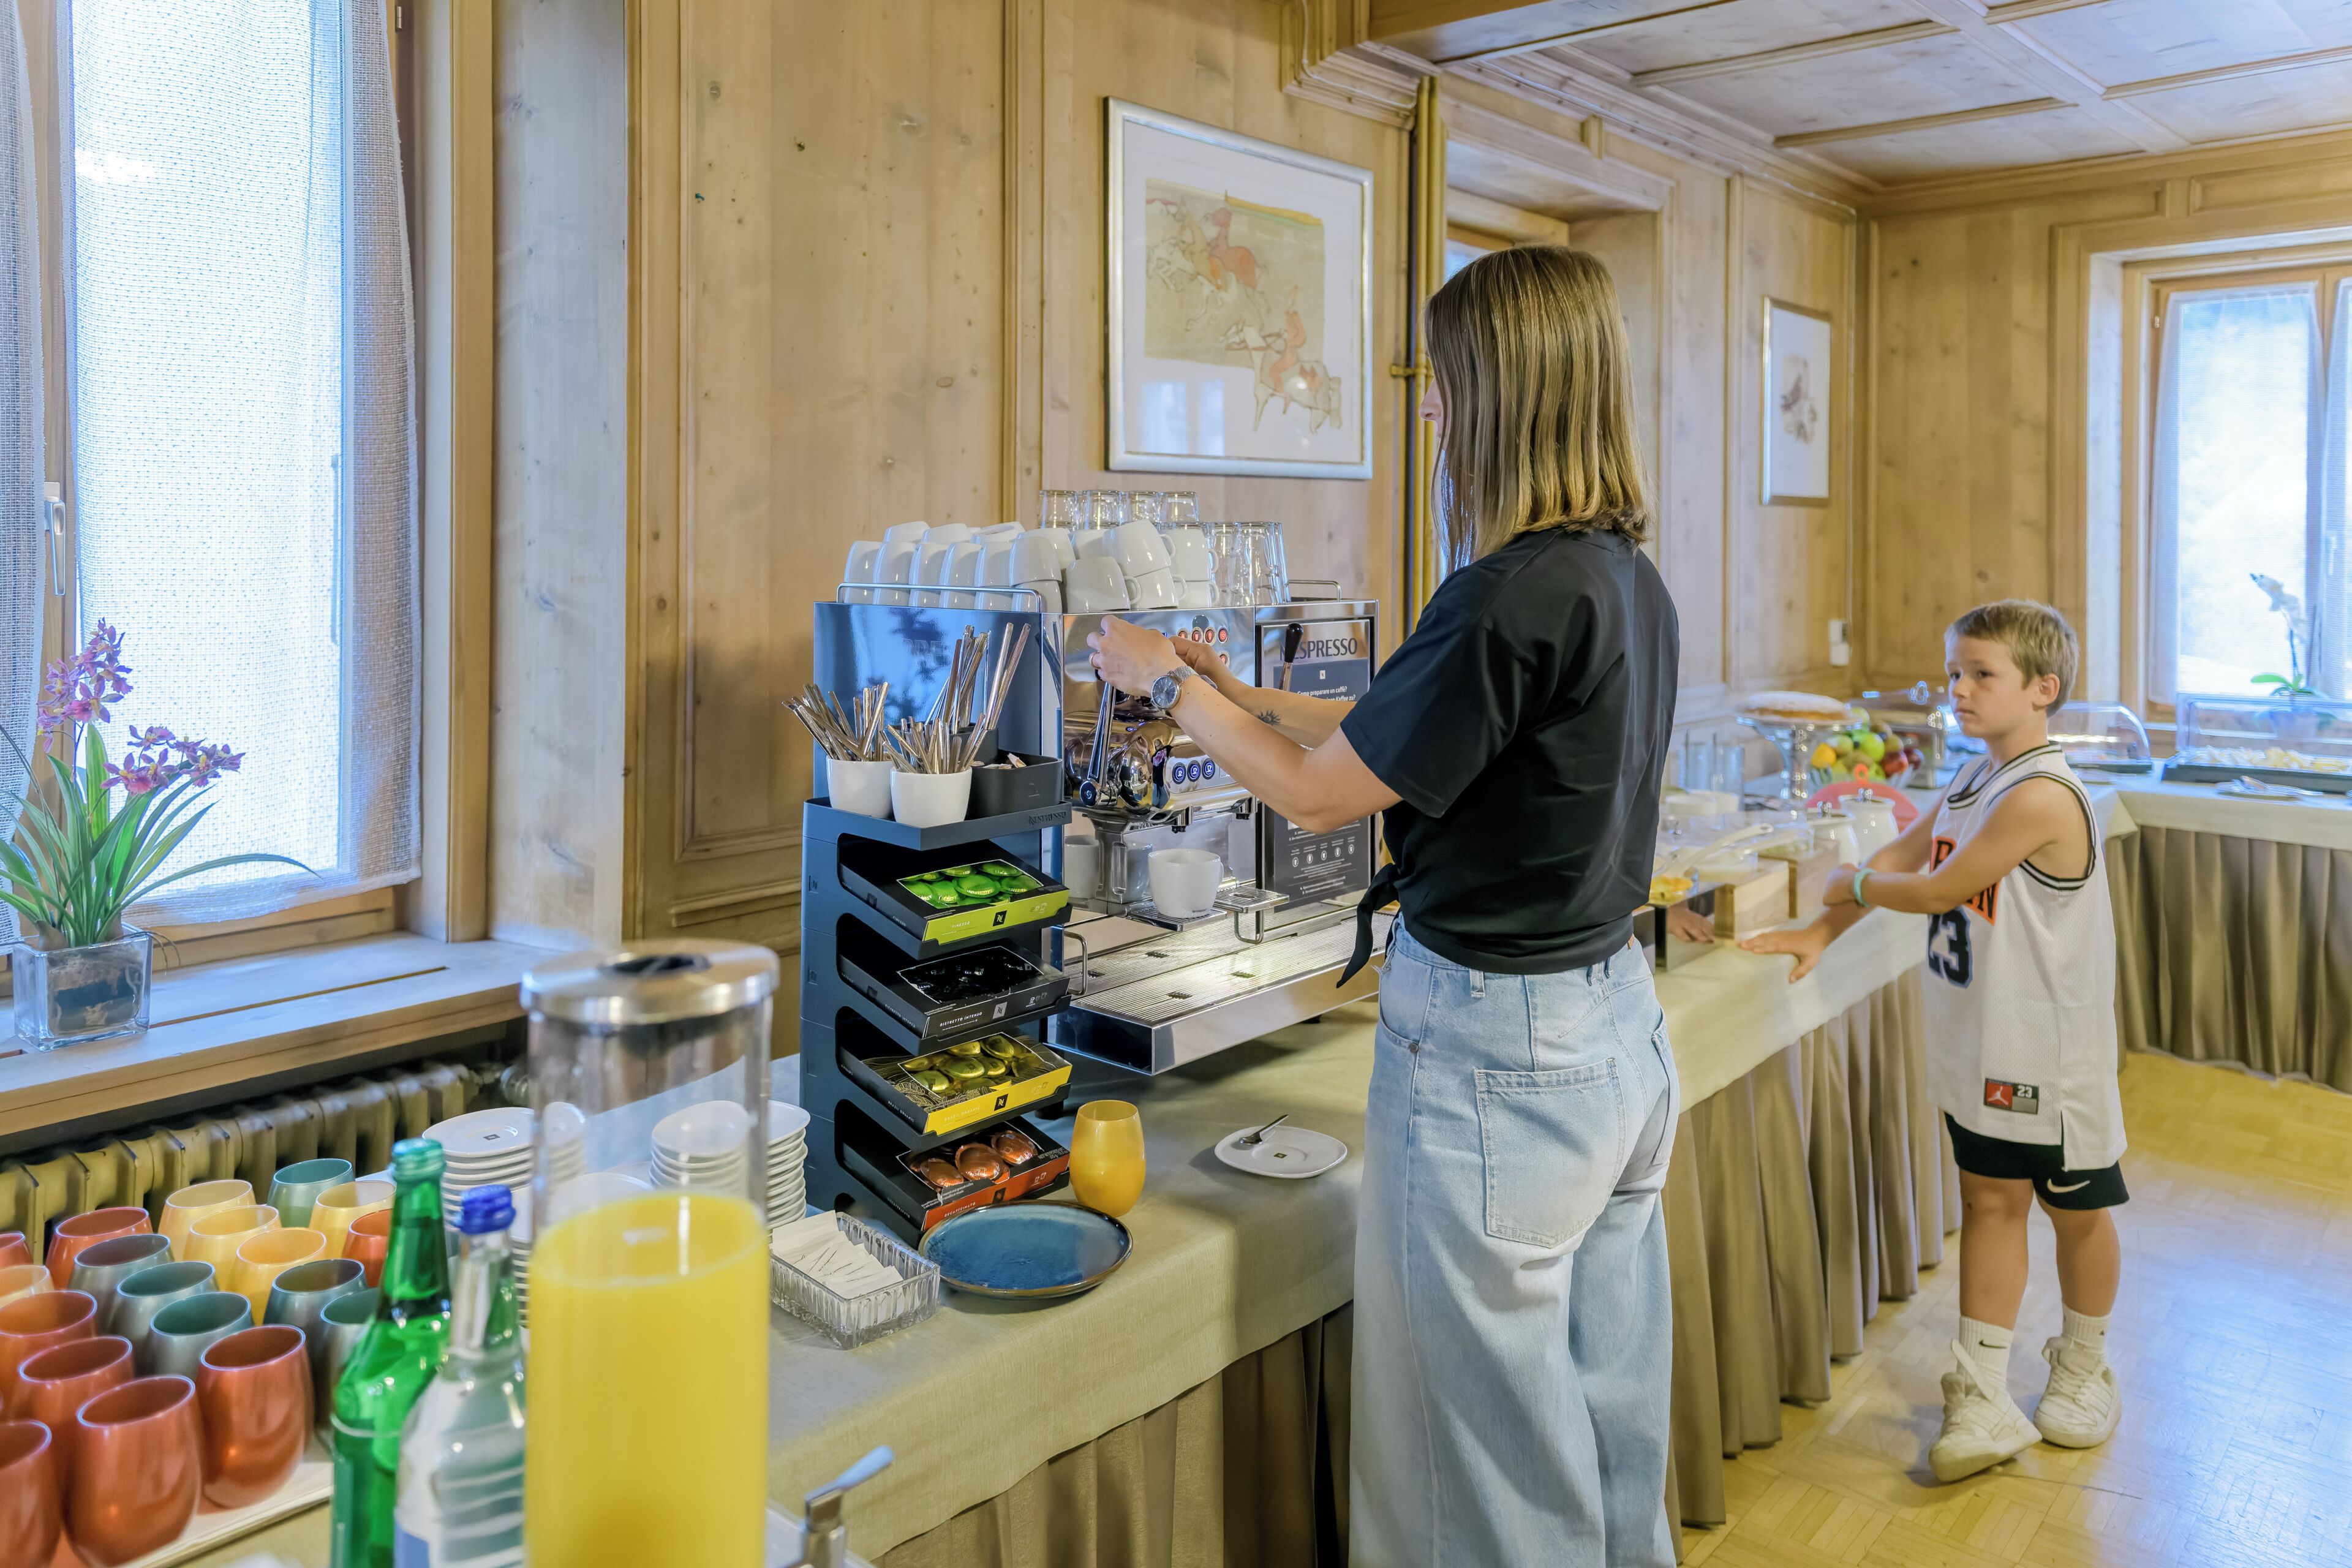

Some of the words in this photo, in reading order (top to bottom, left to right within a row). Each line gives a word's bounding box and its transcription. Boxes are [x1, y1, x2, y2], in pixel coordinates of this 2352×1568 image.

[1279, 638, 1358, 661] NSPRESSO
[940, 1017, 963, 1027] RISTRETTO
[964, 1012, 982, 1020] INTENSO
[2018, 1085, 2033, 1098] 23
[944, 1202, 976, 1218] DECAFFEINATO
